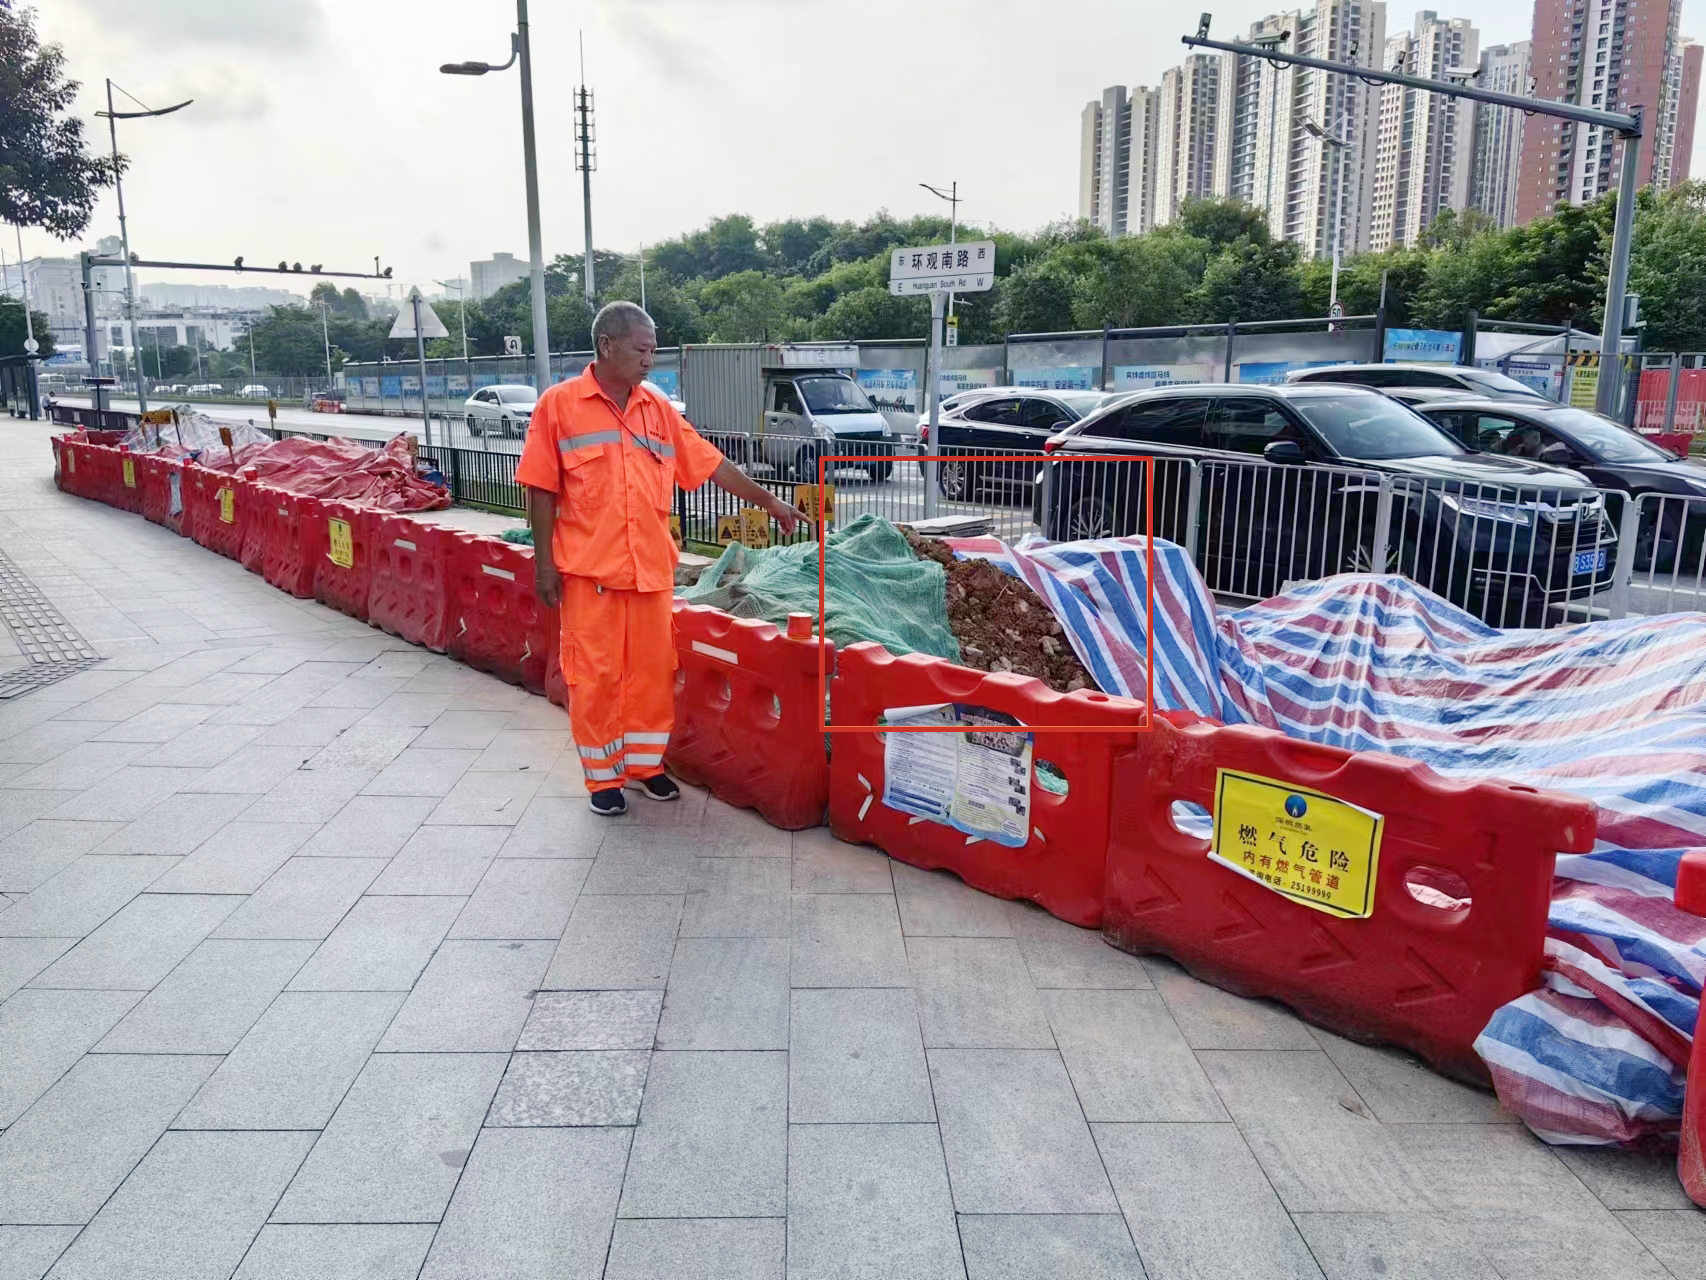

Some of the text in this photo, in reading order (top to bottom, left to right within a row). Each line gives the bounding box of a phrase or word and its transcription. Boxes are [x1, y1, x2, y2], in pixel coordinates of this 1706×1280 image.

[898, 248, 986, 270] 东 环观南路 西
[897, 277, 985, 292] E Huanguan South Rd W
[1238, 823, 1351, 873] 燃气危险
[1243, 850, 1341, 890] 内有燃气管道
